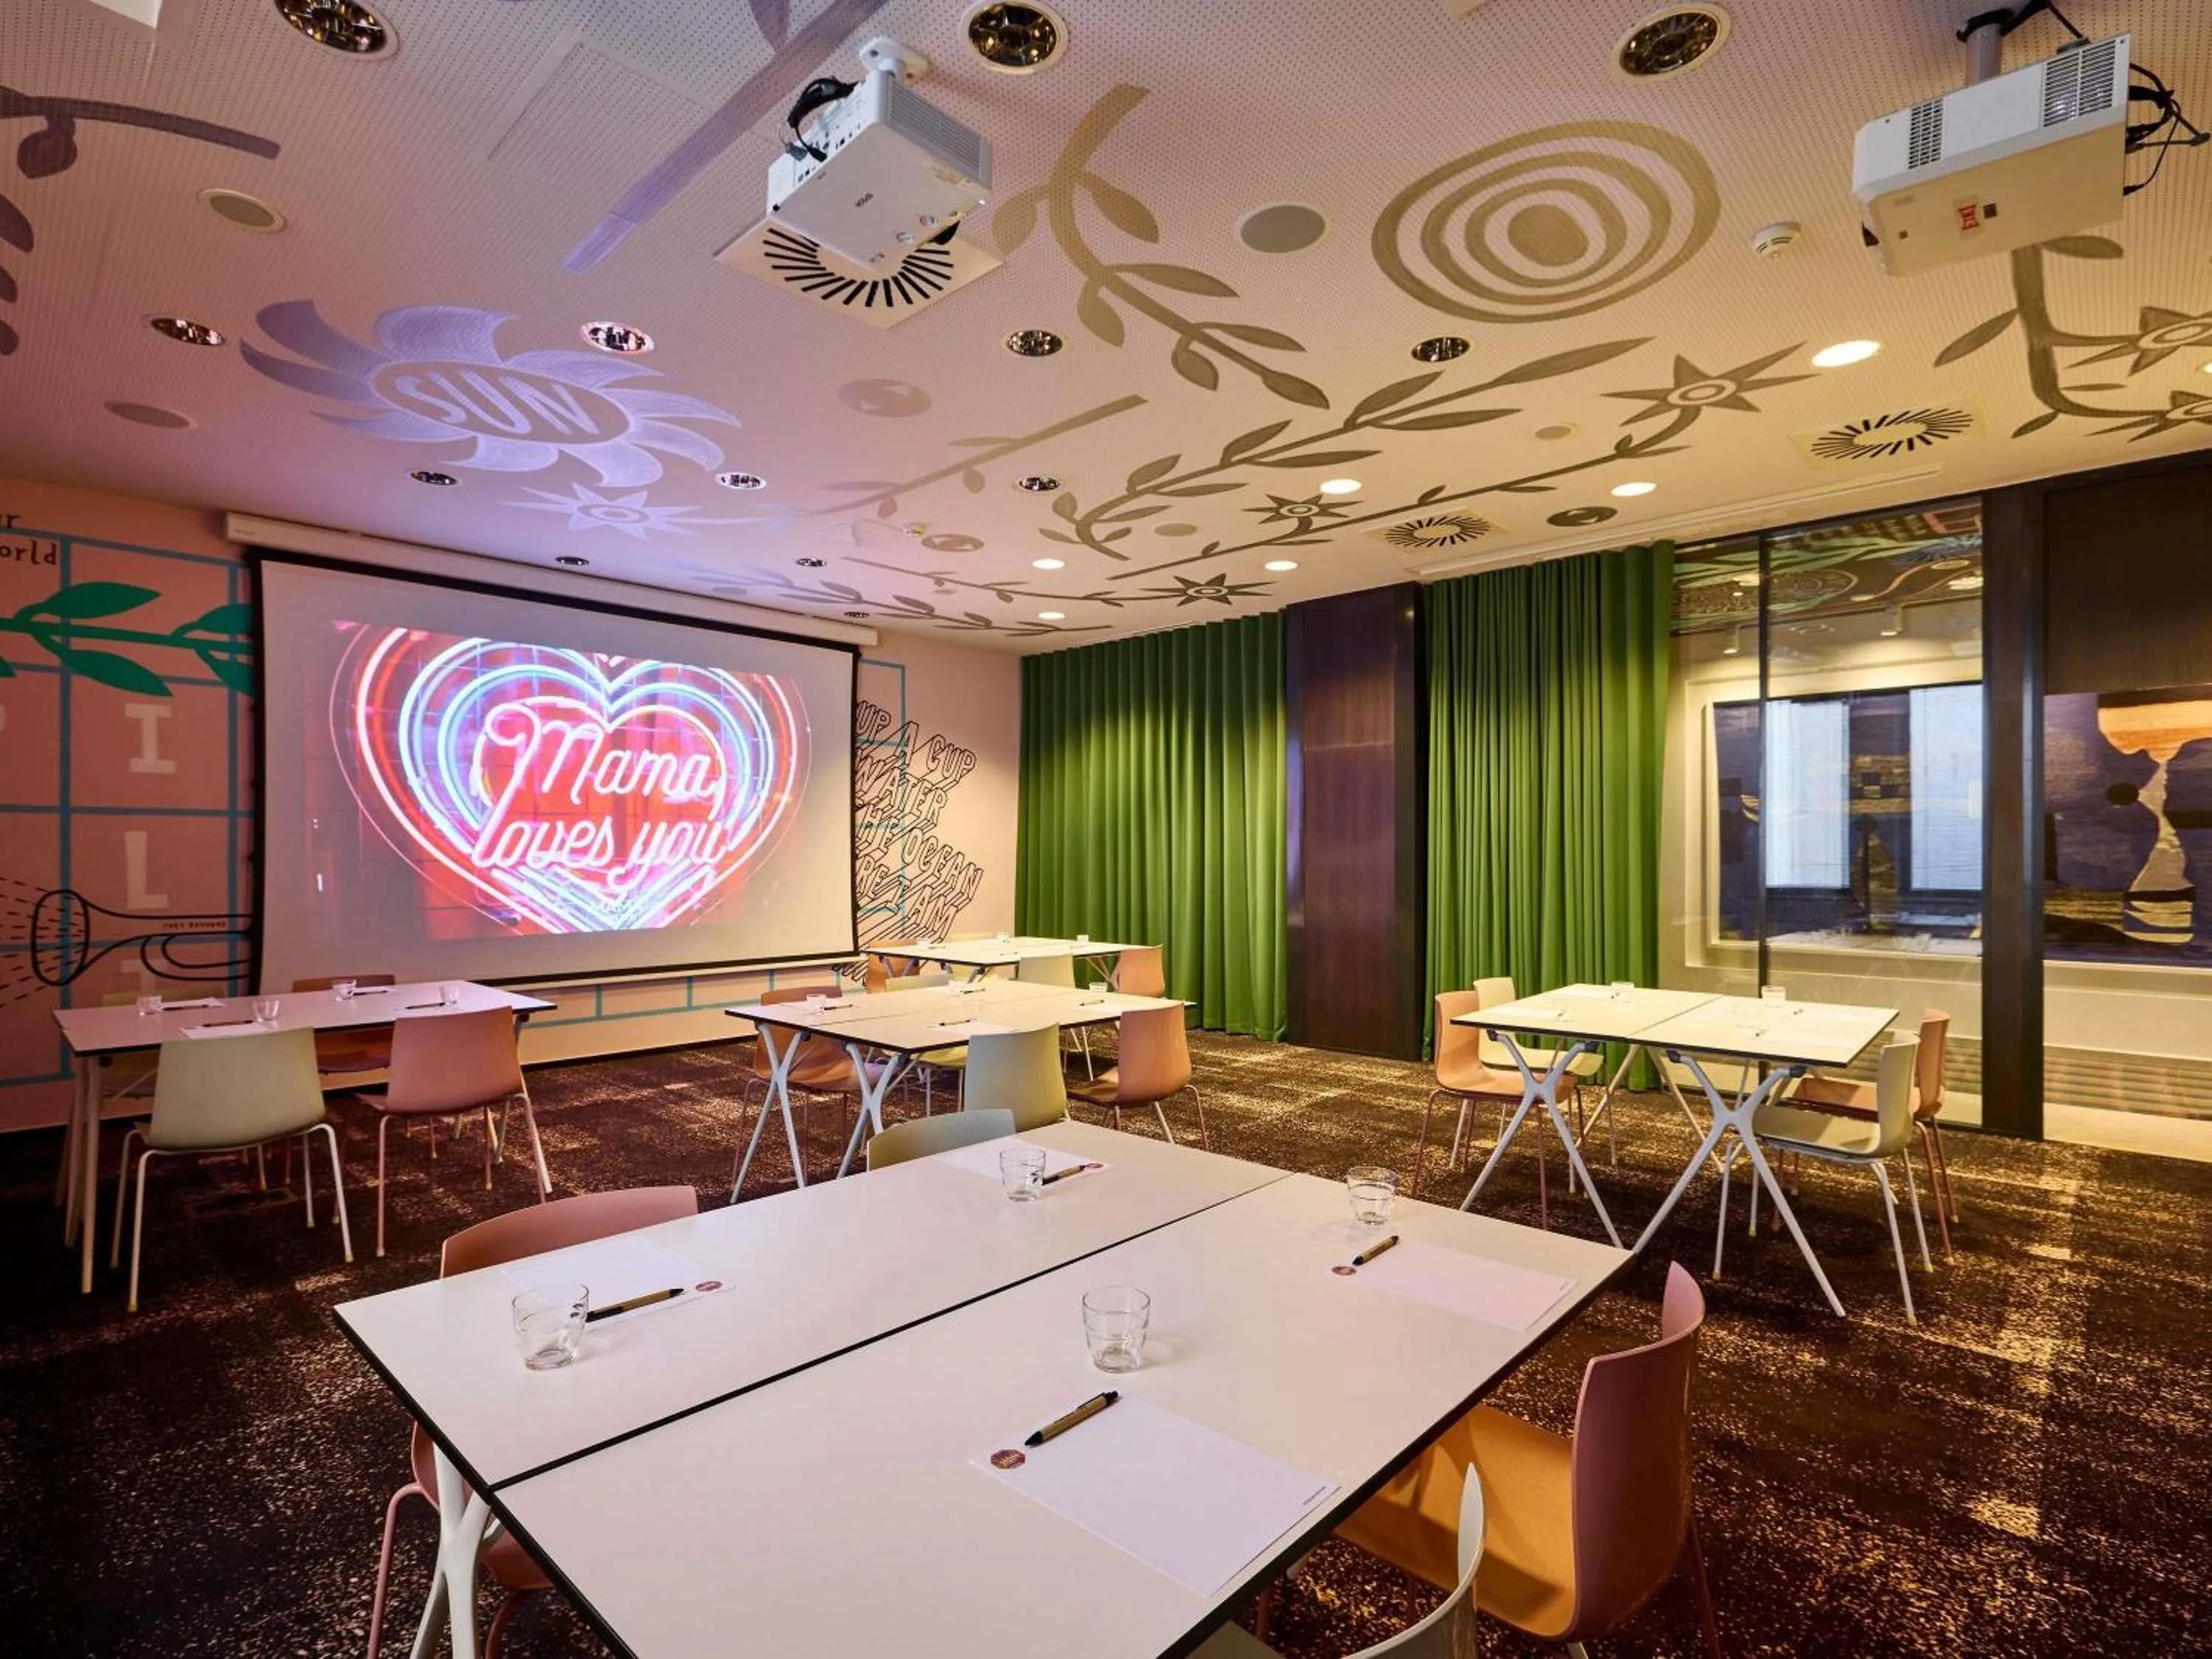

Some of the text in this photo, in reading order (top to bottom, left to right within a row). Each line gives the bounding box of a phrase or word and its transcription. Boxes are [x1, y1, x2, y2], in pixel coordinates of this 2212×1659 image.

[395, 371, 602, 435] SUN
[0, 540, 58, 566] orld
[484, 703, 723, 806] Mama
[856, 700, 977, 783] UP A CUP
[855, 748, 949, 827] WATER
[608, 818, 727, 894] you
[856, 801, 984, 902] HE OCEAN
[905, 885, 959, 941] AM
